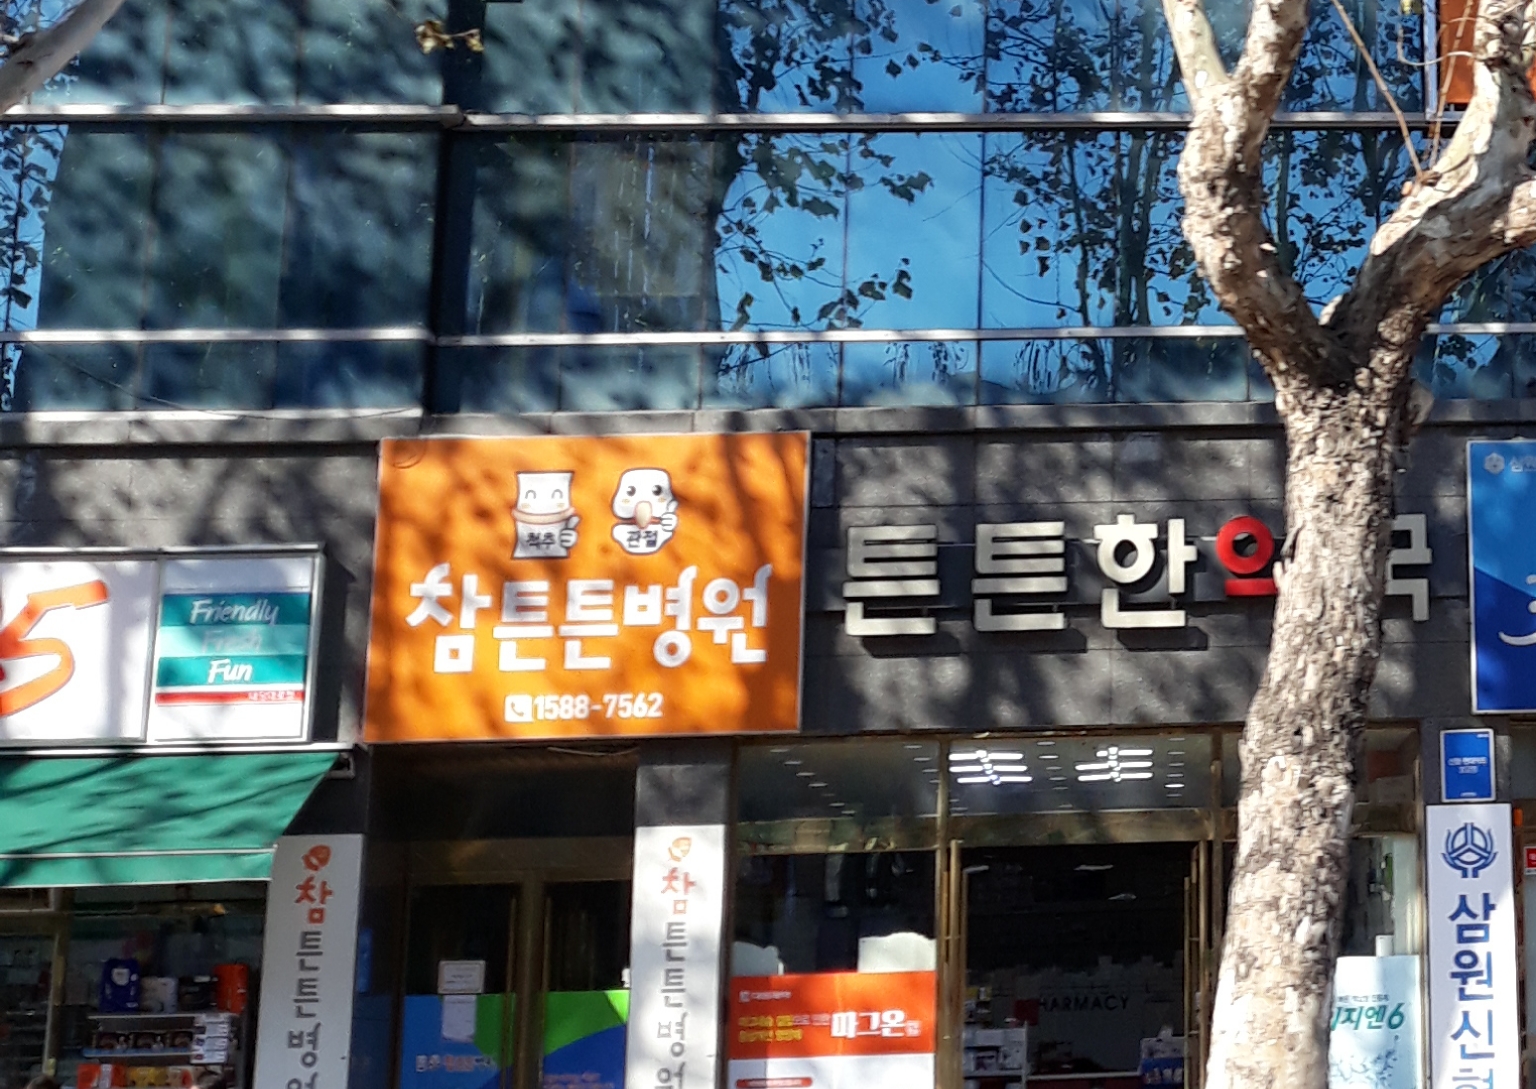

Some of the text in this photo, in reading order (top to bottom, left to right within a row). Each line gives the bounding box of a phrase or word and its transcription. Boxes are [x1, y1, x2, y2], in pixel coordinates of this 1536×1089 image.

[525, 530, 557, 549] 척추
[626, 529, 660, 550] 관절
[190, 598, 280, 626] Friendly
[405, 563, 773, 674] 참튼튼병원
[207, 658, 253, 684] Fun
[533, 692, 664, 720] 1588-7562
